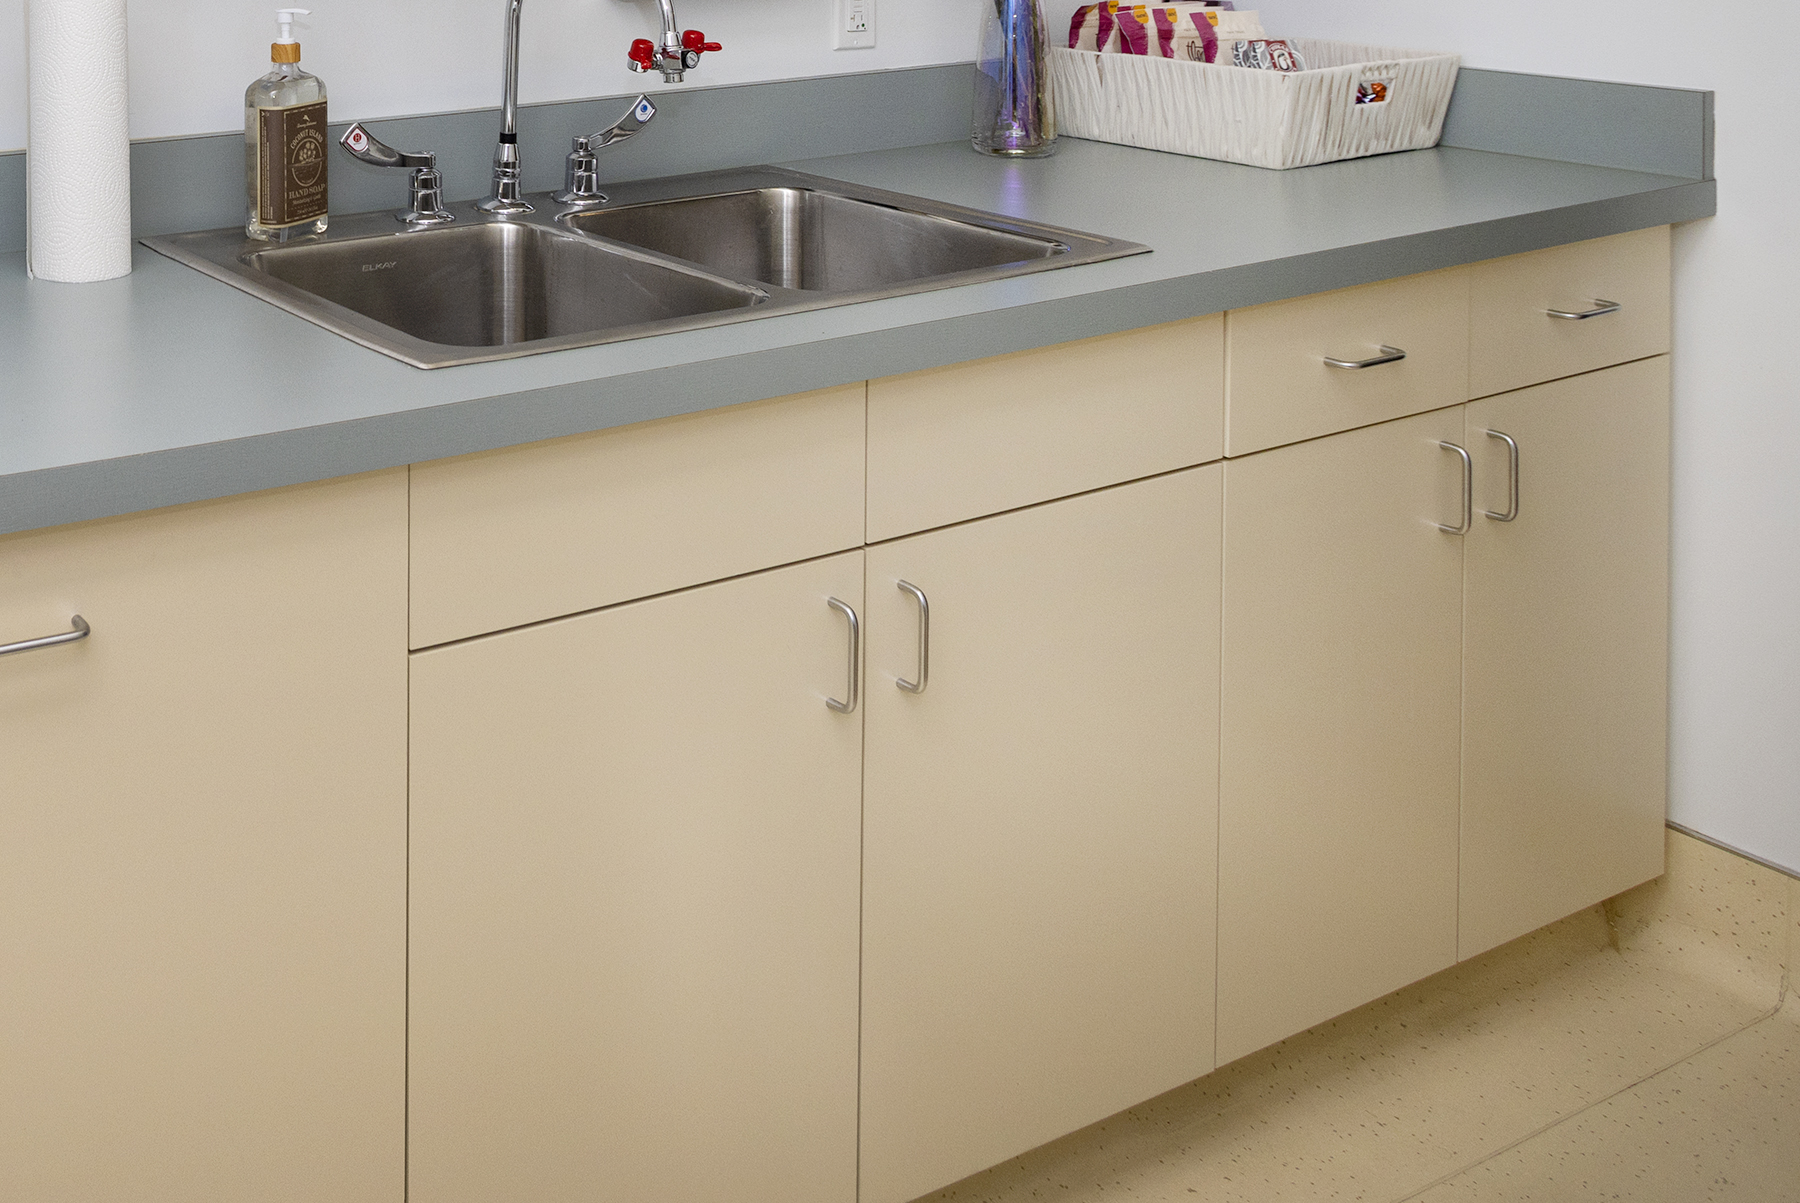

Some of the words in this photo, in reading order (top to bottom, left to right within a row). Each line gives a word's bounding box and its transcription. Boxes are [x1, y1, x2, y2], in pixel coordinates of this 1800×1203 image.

[289, 188, 308, 199] HAND
[309, 183, 325, 194] SOAP
[362, 261, 397, 272] ELKAY
